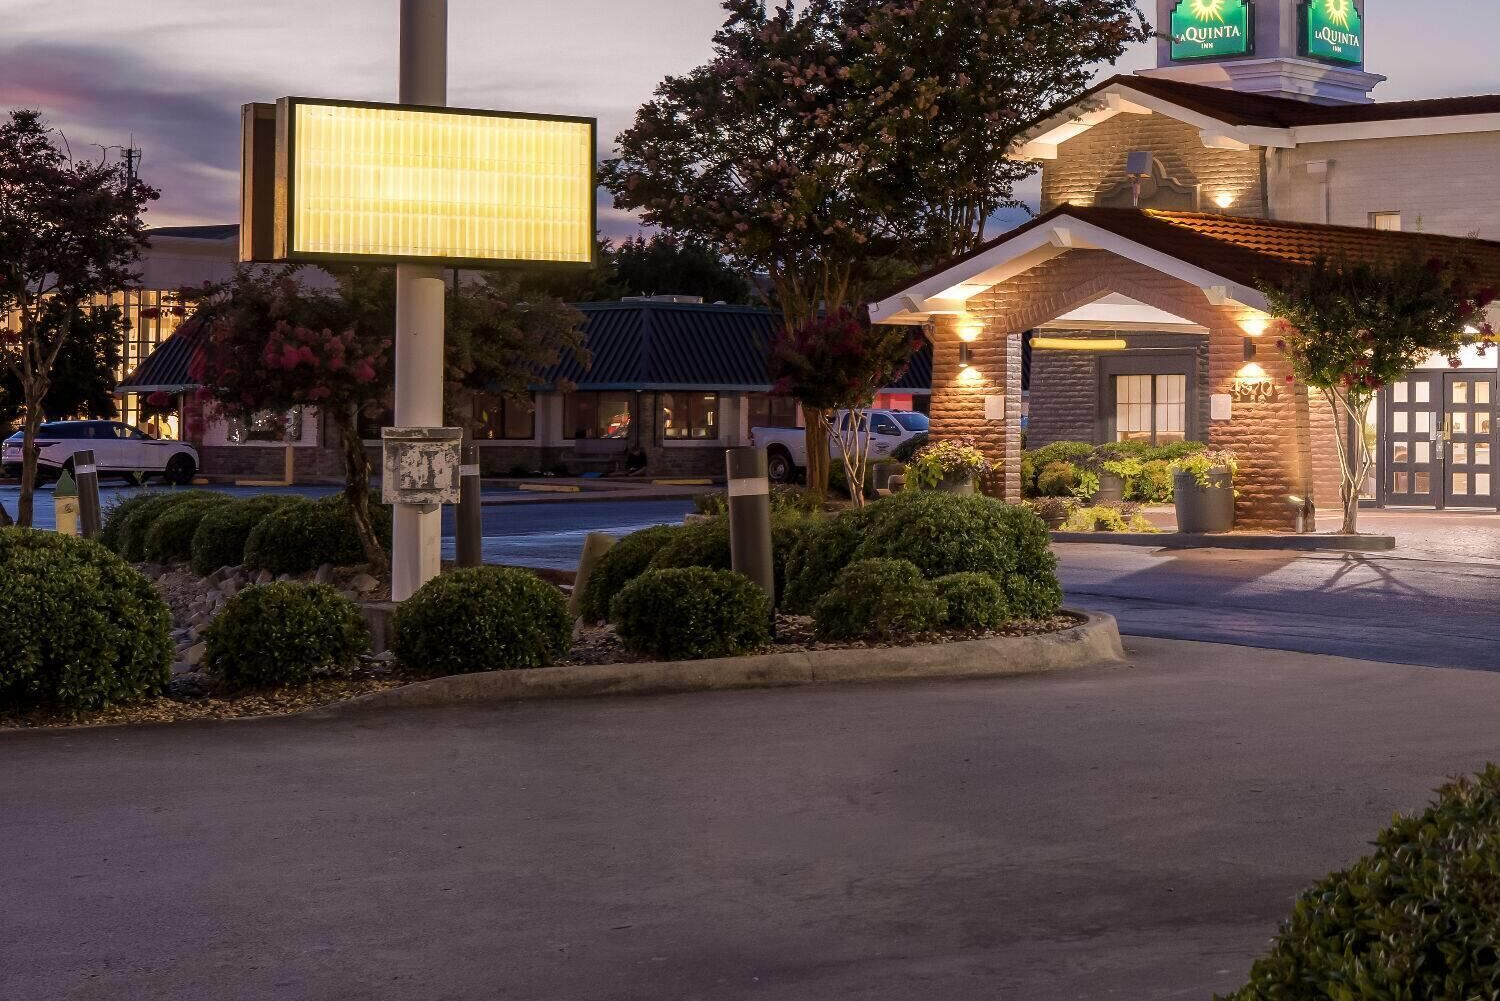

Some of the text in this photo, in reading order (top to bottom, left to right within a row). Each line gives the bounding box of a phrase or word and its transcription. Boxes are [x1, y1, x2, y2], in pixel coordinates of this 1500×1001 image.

[1186, 25, 1240, 43] QUINTA
[1322, 26, 1359, 47] QUINTA
[1332, 45, 1342, 53] INN
